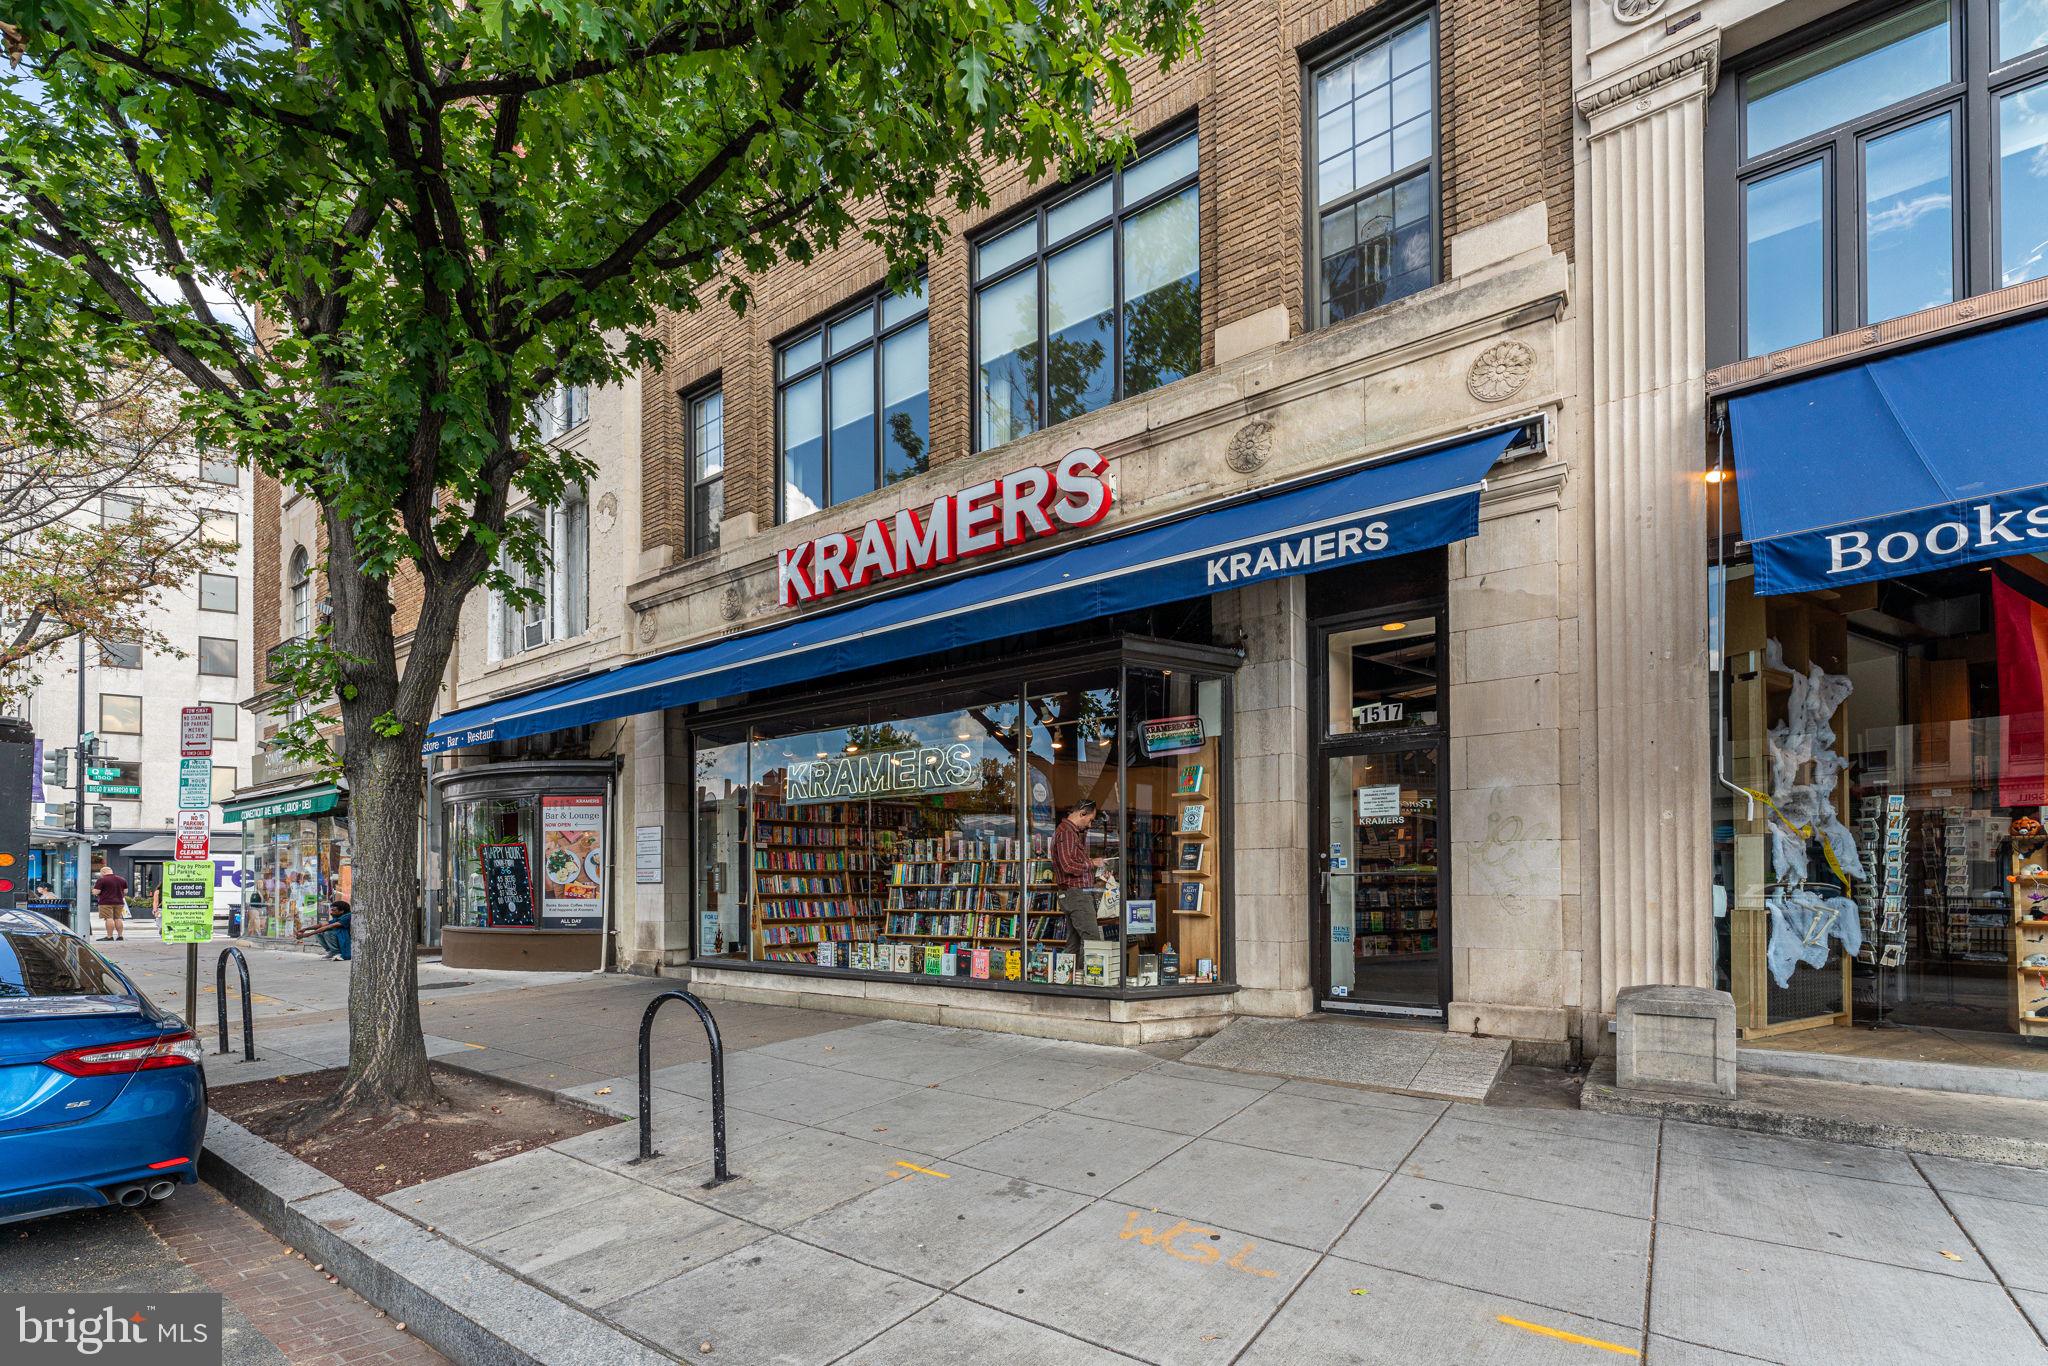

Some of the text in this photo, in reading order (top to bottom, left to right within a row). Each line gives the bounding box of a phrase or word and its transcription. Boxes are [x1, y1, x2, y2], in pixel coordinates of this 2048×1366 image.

[777, 447, 1112, 607] KRAMERS
[1825, 504, 2048, 574] Books
[1207, 521, 1389, 586] KRAMERS
[1361, 704, 1400, 722] 1517
[1145, 720, 1200, 734] KRAMERBOOKS
[421, 740, 440, 753] store
[447, 736, 459, 748] Bar
[786, 743, 972, 800] KRAMERS
[285, 803, 300, 813] LIQUOR
[545, 812, 559, 820] Bar
[569, 812, 600, 820] Lounge
[1359, 816, 1405, 825] KRAMERS
[65, 1099, 91, 1109] SE
